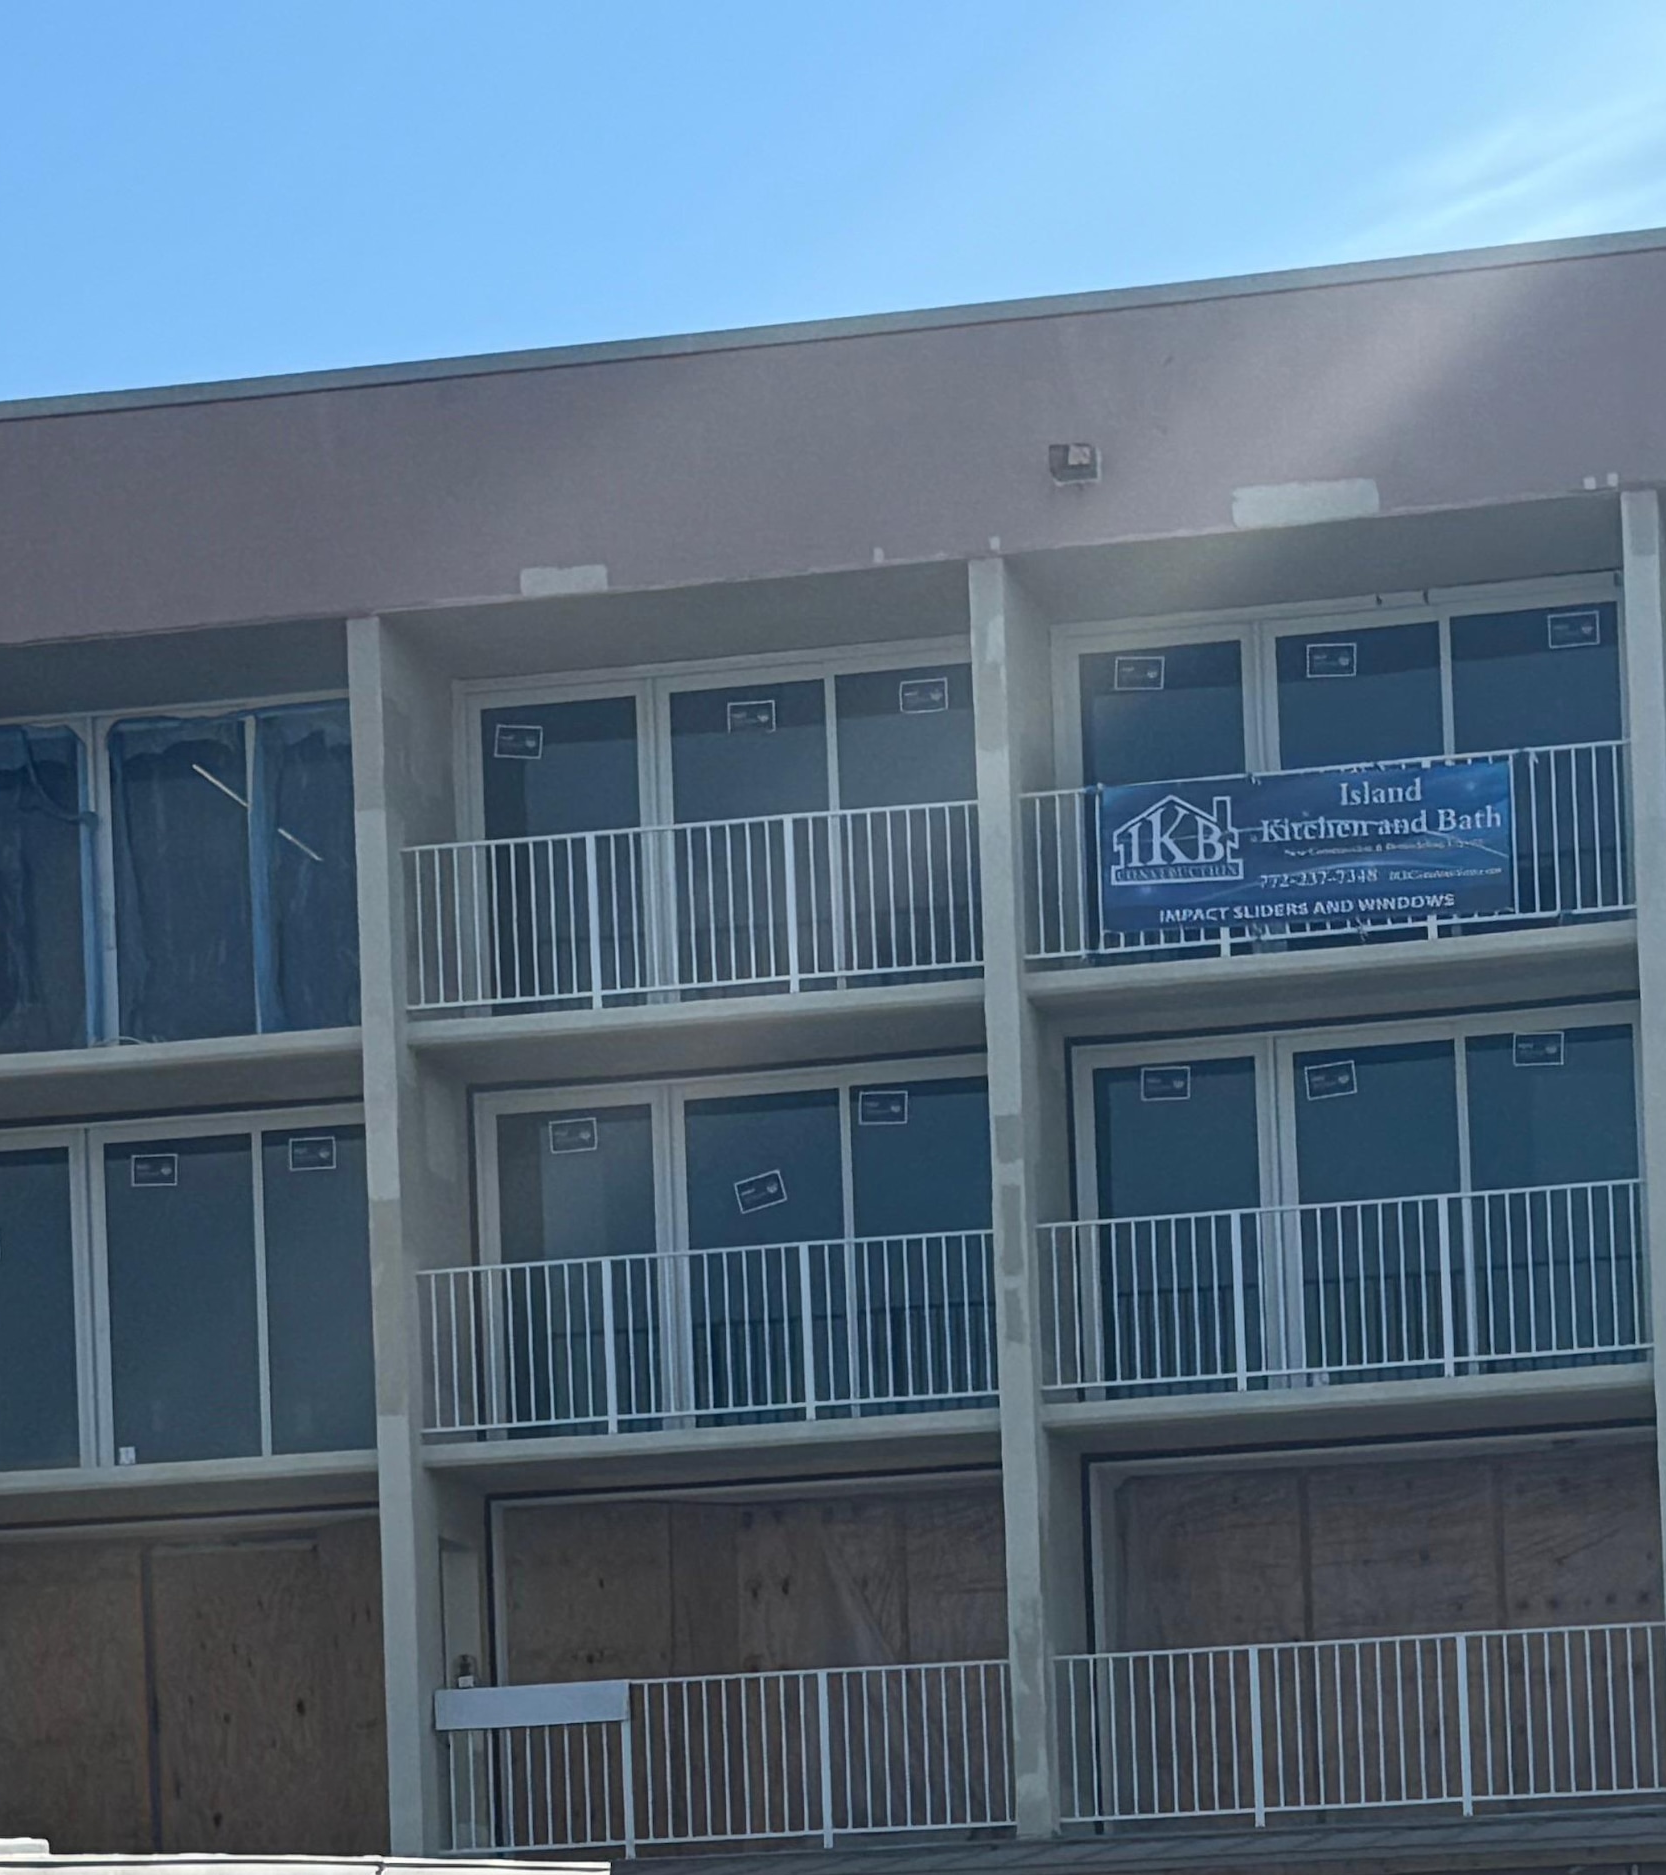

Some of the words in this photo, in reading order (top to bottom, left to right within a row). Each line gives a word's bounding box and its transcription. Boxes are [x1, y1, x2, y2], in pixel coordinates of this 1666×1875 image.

[1339, 777, 1423, 806] Island
[1126, 804, 1227, 868] IKB
[1259, 816, 1370, 843] Kitchen
[1377, 809, 1428, 835] and
[1437, 804, 1502, 832] Bath
[1159, 906, 1230, 923] IMPACT
[1233, 902, 1309, 920] SLIDERS
[1312, 899, 1355, 915] AND
[1358, 893, 1455, 912] WINDOWS
